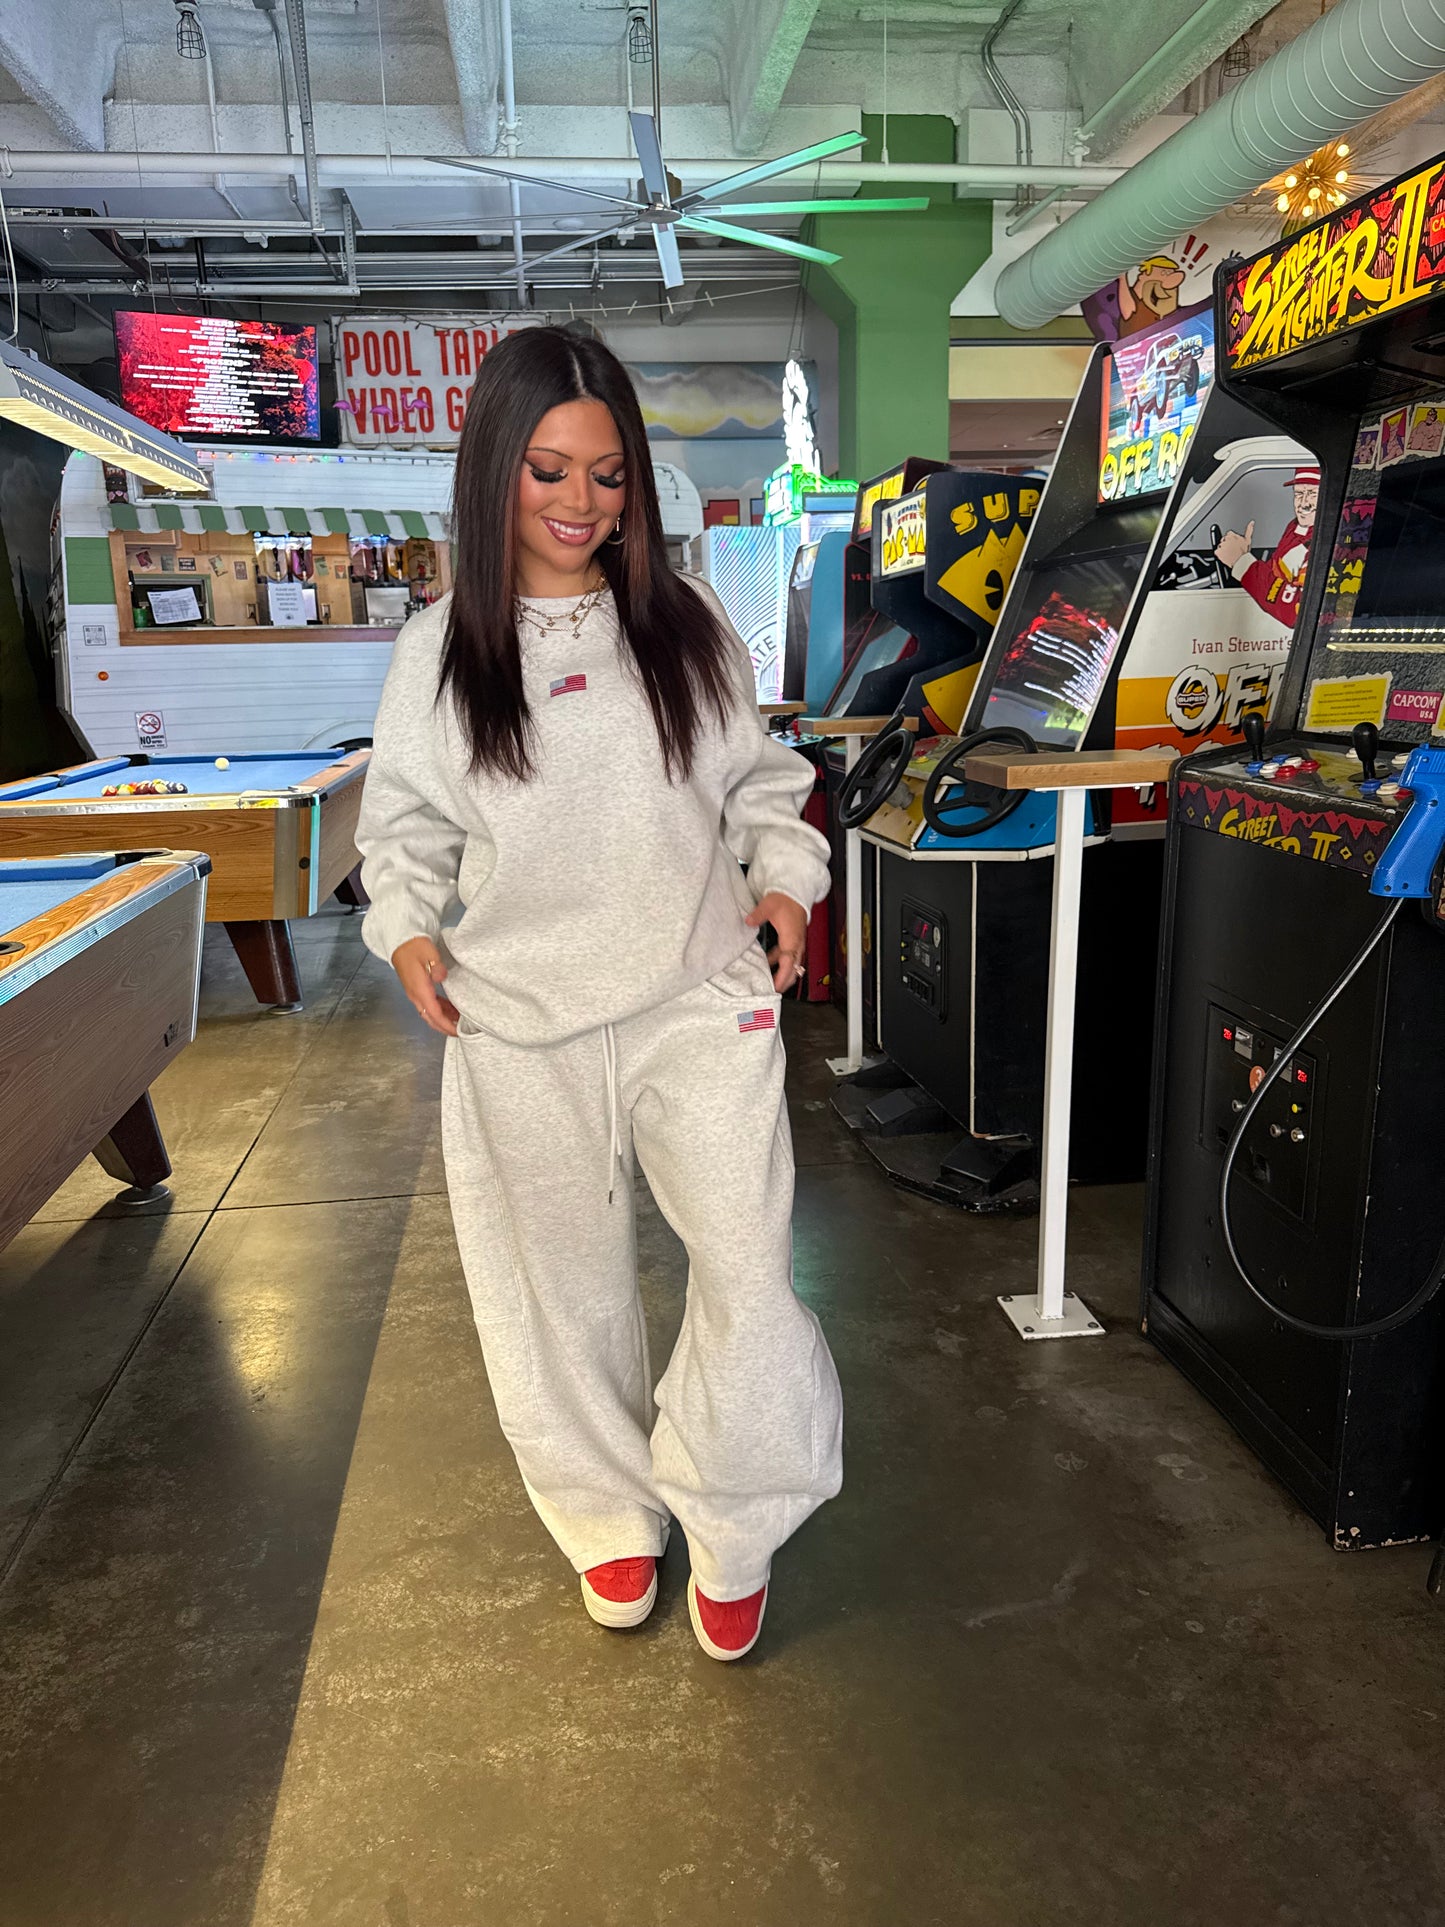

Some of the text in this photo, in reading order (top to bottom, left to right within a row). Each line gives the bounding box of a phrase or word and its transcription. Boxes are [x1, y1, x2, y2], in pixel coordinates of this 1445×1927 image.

[1236, 222, 1330, 363] STREET
[1254, 219, 1392, 355] FIGHTER
[343, 329, 520, 377] POOL TAB
[347, 386, 434, 434] VIDEO
[1100, 438, 1154, 501] OFF
[1191, 638, 1224, 655] Ivan
[1178, 695, 1206, 703] SUPER
[1393, 693, 1437, 709] CAPCOM
[1420, 710, 1434, 719] USA
[140, 735, 151, 745] NO
[1219, 808, 1278, 841] STREET
